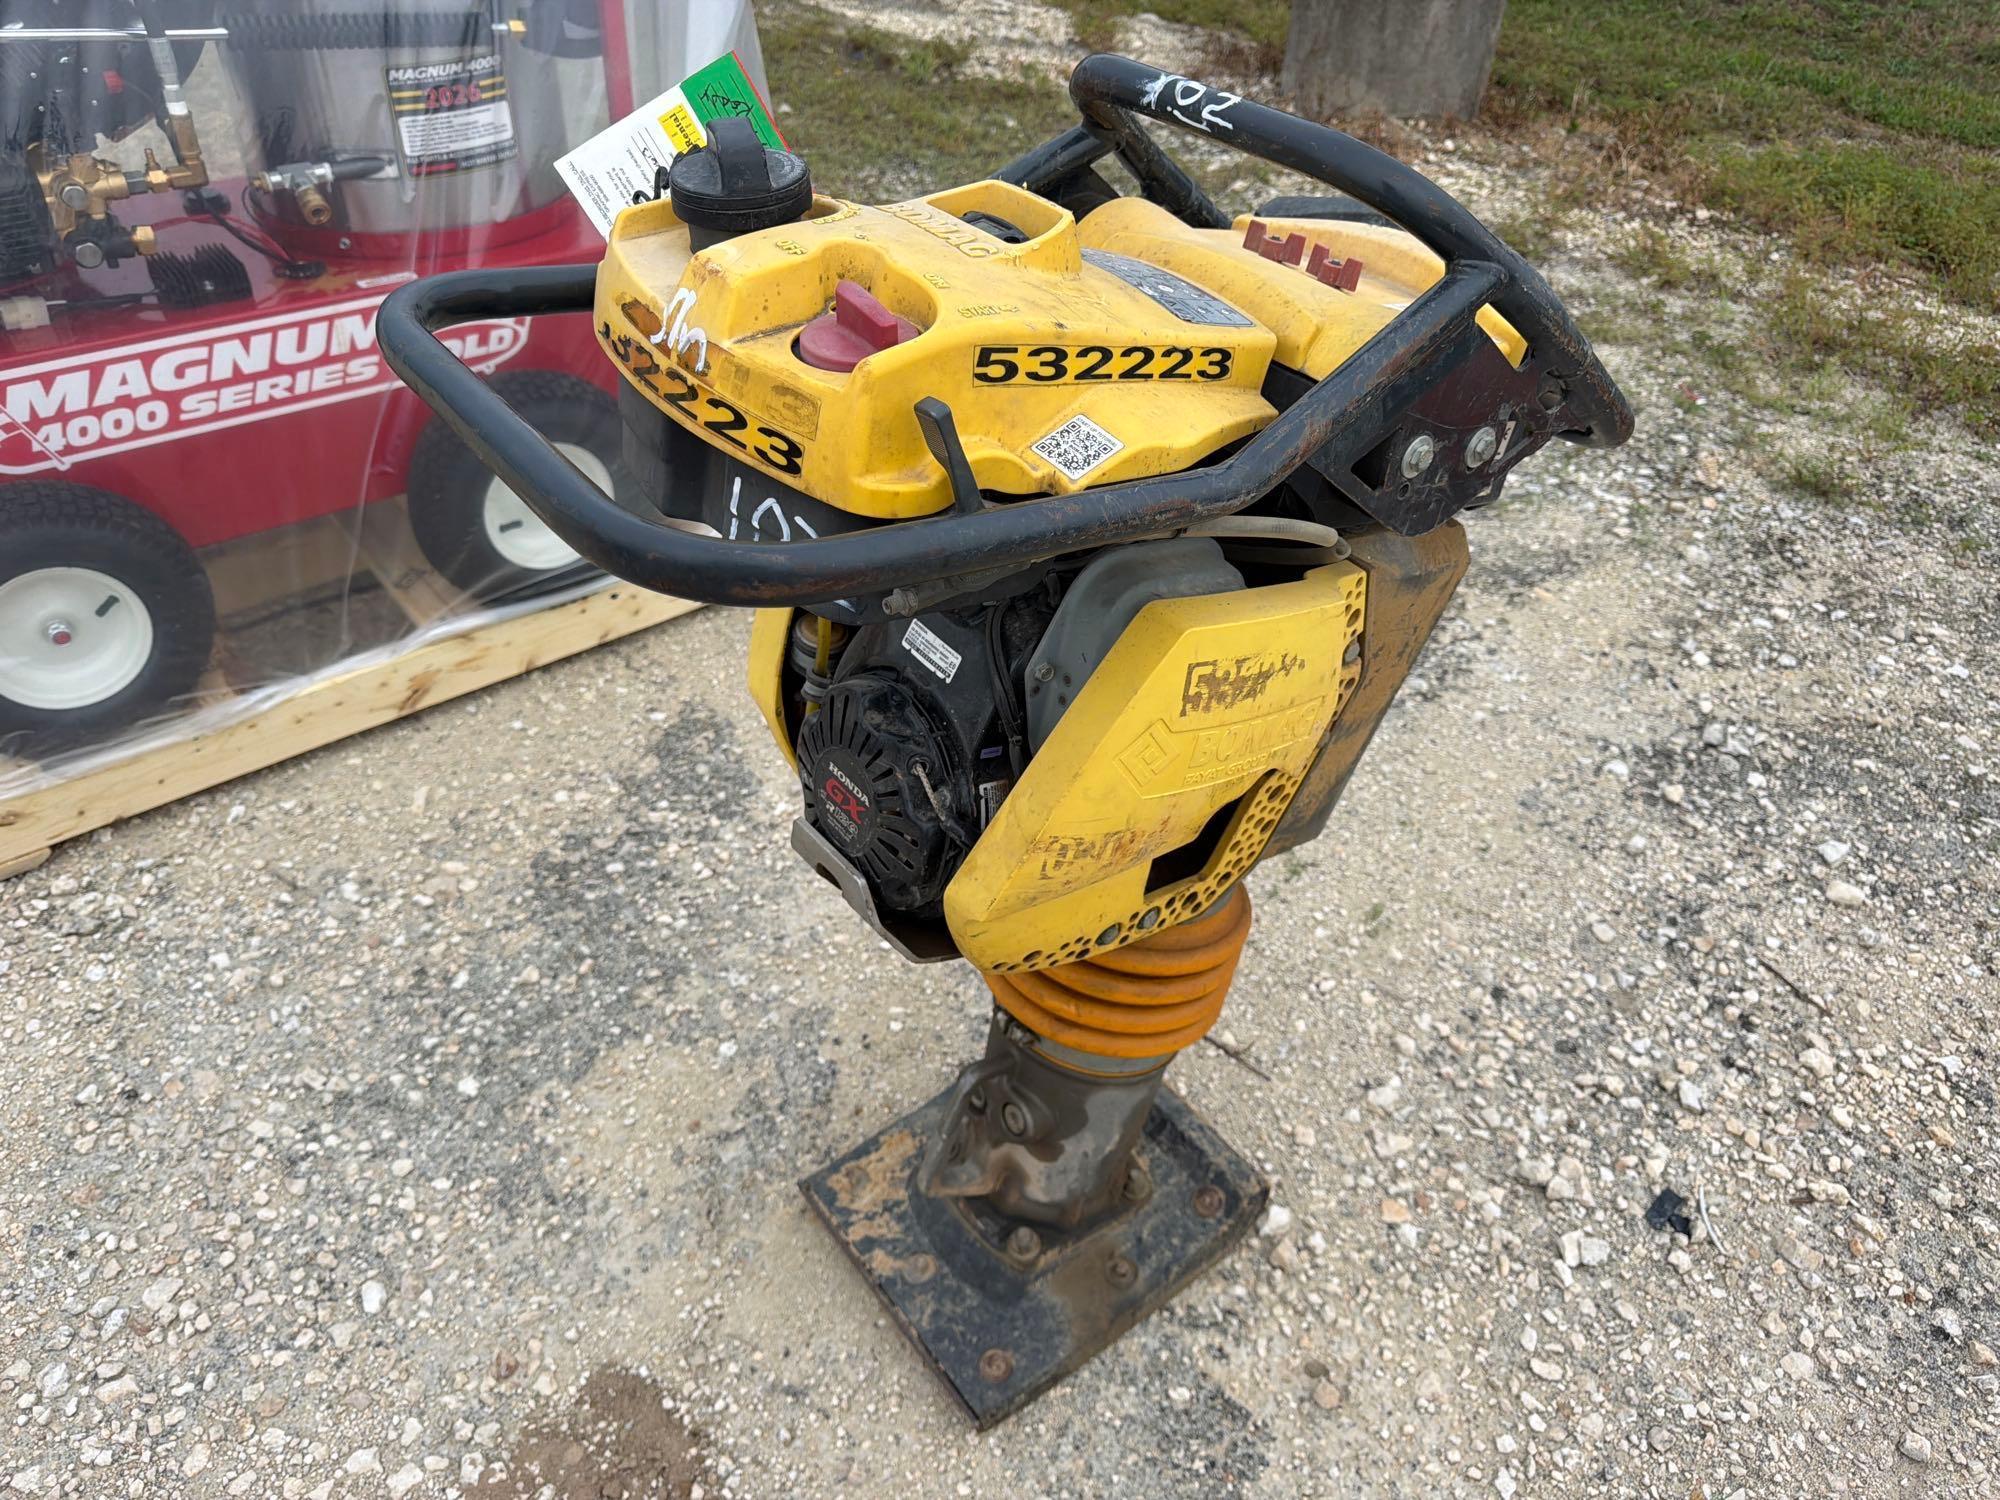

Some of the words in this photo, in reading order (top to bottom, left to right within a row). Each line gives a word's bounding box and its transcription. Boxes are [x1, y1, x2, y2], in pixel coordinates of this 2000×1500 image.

[389, 62, 463, 81] MAGNUM
[466, 55, 501, 72] 4000
[425, 80, 481, 109] 2026
[668, 112, 694, 149] Rental
[775, 239, 808, 256] OFF
[6, 311, 380, 424] MAGNUM
[974, 346, 1232, 384] 532223
[31, 399, 169, 453] 4000
[179, 355, 380, 421] SERIES
[829, 761, 870, 808] HONDA
[1184, 764, 1226, 785] FAYAT
[826, 779, 865, 828] GX
